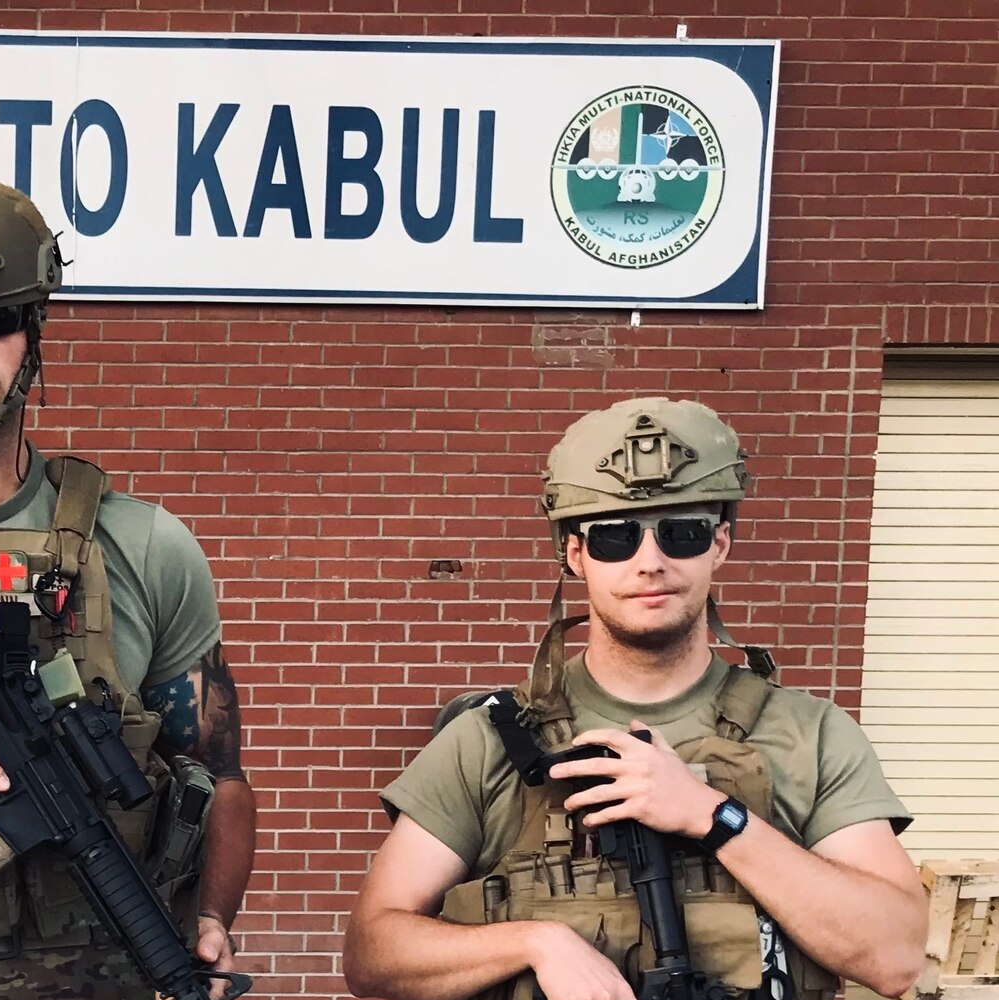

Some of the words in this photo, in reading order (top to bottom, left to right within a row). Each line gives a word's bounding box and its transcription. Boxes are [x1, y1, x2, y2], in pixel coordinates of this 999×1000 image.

[558, 126, 580, 163] HKIA
[578, 91, 692, 127] MULTI-NATIONAL
[694, 118, 720, 165] FORCE
[175, 102, 524, 244] KABUL
[564, 216, 601, 255] KABUL
[608, 219, 706, 264] AFGHANISTAN
[623, 210, 649, 225] RS
